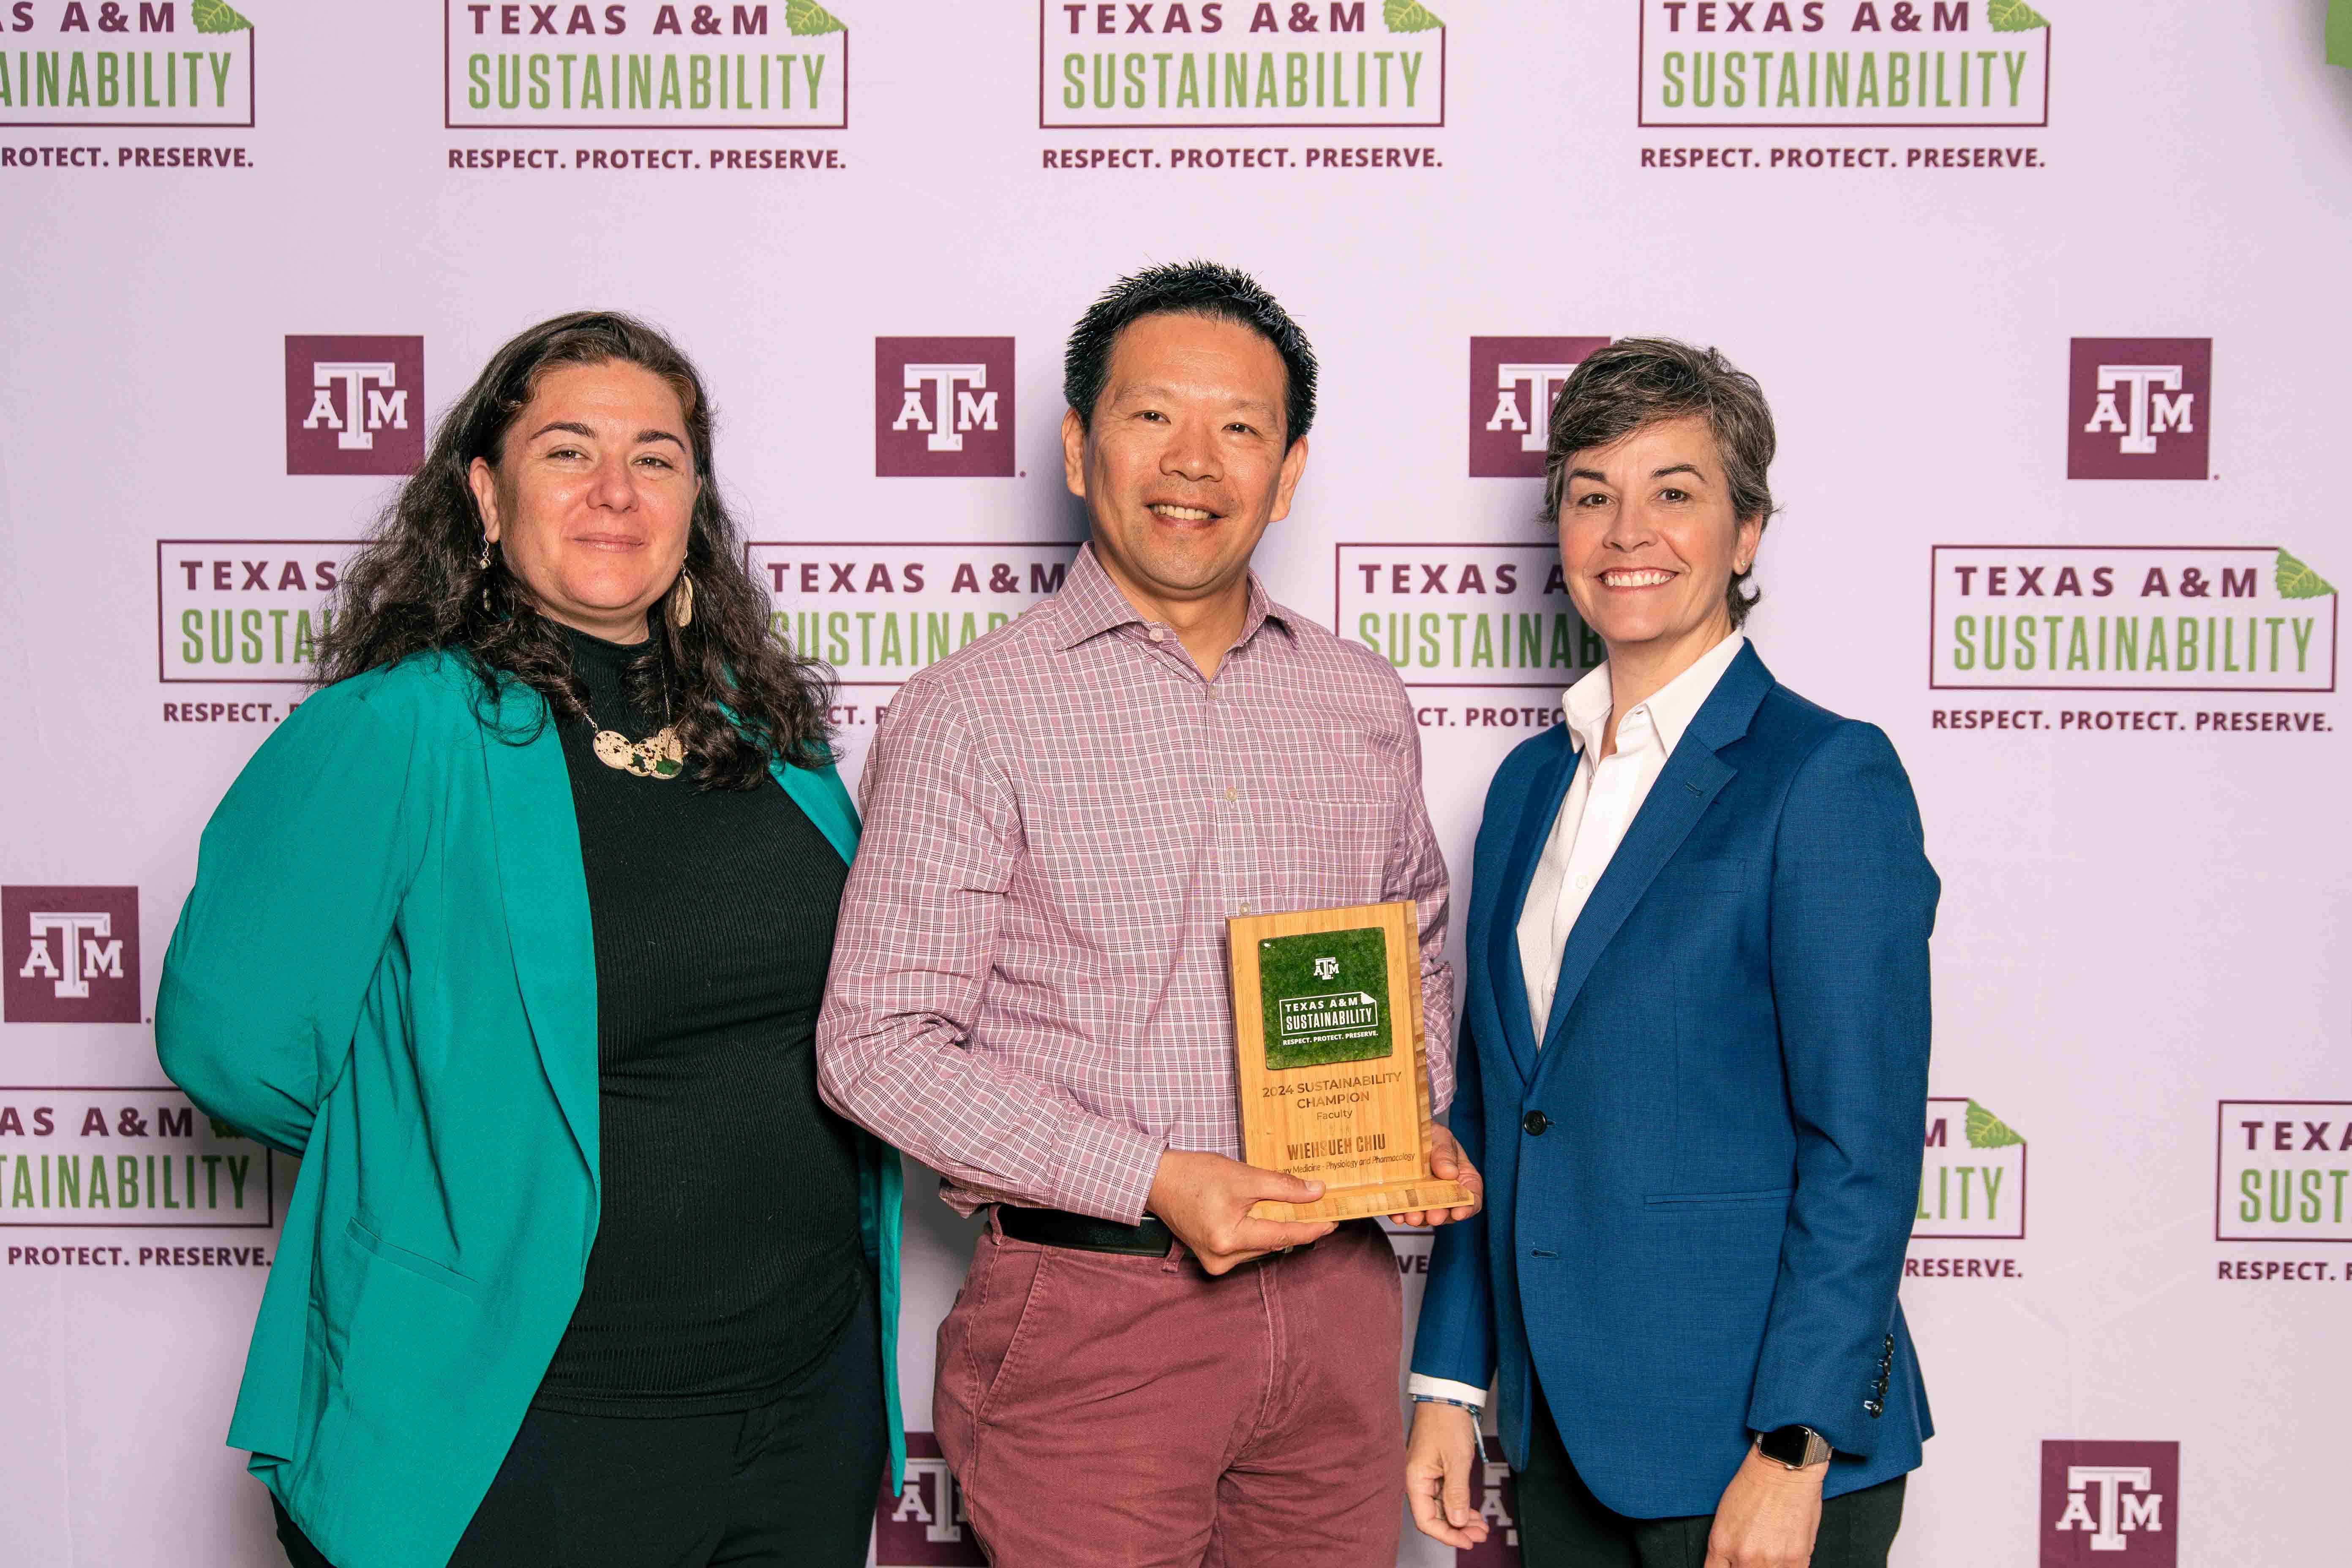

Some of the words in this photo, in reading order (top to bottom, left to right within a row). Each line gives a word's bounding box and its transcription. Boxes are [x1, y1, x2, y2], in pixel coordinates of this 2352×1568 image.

[60, 2, 174, 33] A&M
[468, 4, 626, 35] TEXAS
[653, 5, 767, 35] A&M
[1063, 3, 1222, 34] TEXAS
[1249, 2, 1365, 33] A&M
[1663, 2, 1823, 32] TEXAS
[1851, 1, 1968, 32] A&M
[469, 53, 825, 109] SUSTAINABILITY
[1063, 50, 1423, 109] SUSTAINABILITY
[1662, 50, 2026, 108] SUSTAINABILITY
[119, 147, 253, 167] PRESERVE.
[449, 149, 566, 169] RESPECT.
[576, 150, 700, 169] PROTECT.
[711, 150, 846, 169] PRESERVE.
[1043, 149, 1161, 169] RESPECT.
[1171, 148, 1296, 168] PROTECT.
[1306, 148, 1442, 167] PRESERVE.
[1641, 148, 1760, 167] RESPECT.
[1771, 148, 1897, 167] PROTECT.
[1907, 148, 2044, 167] PRESERVE.
[180, 561, 338, 591] TEXAS
[767, 563, 925, 593] TEXAS
[951, 563, 1064, 593] A&M
[1358, 563, 1518, 595] TEXAS
[1955, 566, 2113, 597] TEXAS
[2140, 567, 2257, 598] A&M
[1954, 615, 2314, 673] SUSTAINABILITY
[164, 703, 280, 722] RESPECT.
[1933, 710, 2050, 730] RESPECT.
[2061, 711, 2185, 730] PROTECT.
[2197, 712, 2333, 732] PRESERVE.
[1284, 1000, 1325, 1013] TEXAS
[1329, 997, 1358, 1008] A&M
[1286, 1007, 1372, 1031] SUSTAINABILITY
[1282, 1037, 1312, 1046] RESPECT.
[1313, 1034, 1344, 1043] PROTECT.
[1345, 1030, 1379, 1039] PRESERVE.
[1262, 1085, 1294, 1098] 2024
[1297, 1072, 1403, 1093] SUSTAINABILITY
[1296, 1091, 1370, 1109] CHAMPION
[81, 1107, 193, 1137] A&M
[1316, 1109, 1353, 1121] Faculty
[1356, 1133, 1386, 1152] CHIU
[1293, 1163, 1321, 1173] Medicine
[1326, 1157, 1358, 1171] Physiology
[1359, 1157, 1371, 1166] and
[1372, 1152, 1415, 1164] Pharmacology
[8, 1247, 130, 1266] PROTECT.
[139, 1247, 272, 1266] PRESERVE.
[2218, 1261, 2335, 1280] RESPECT.
